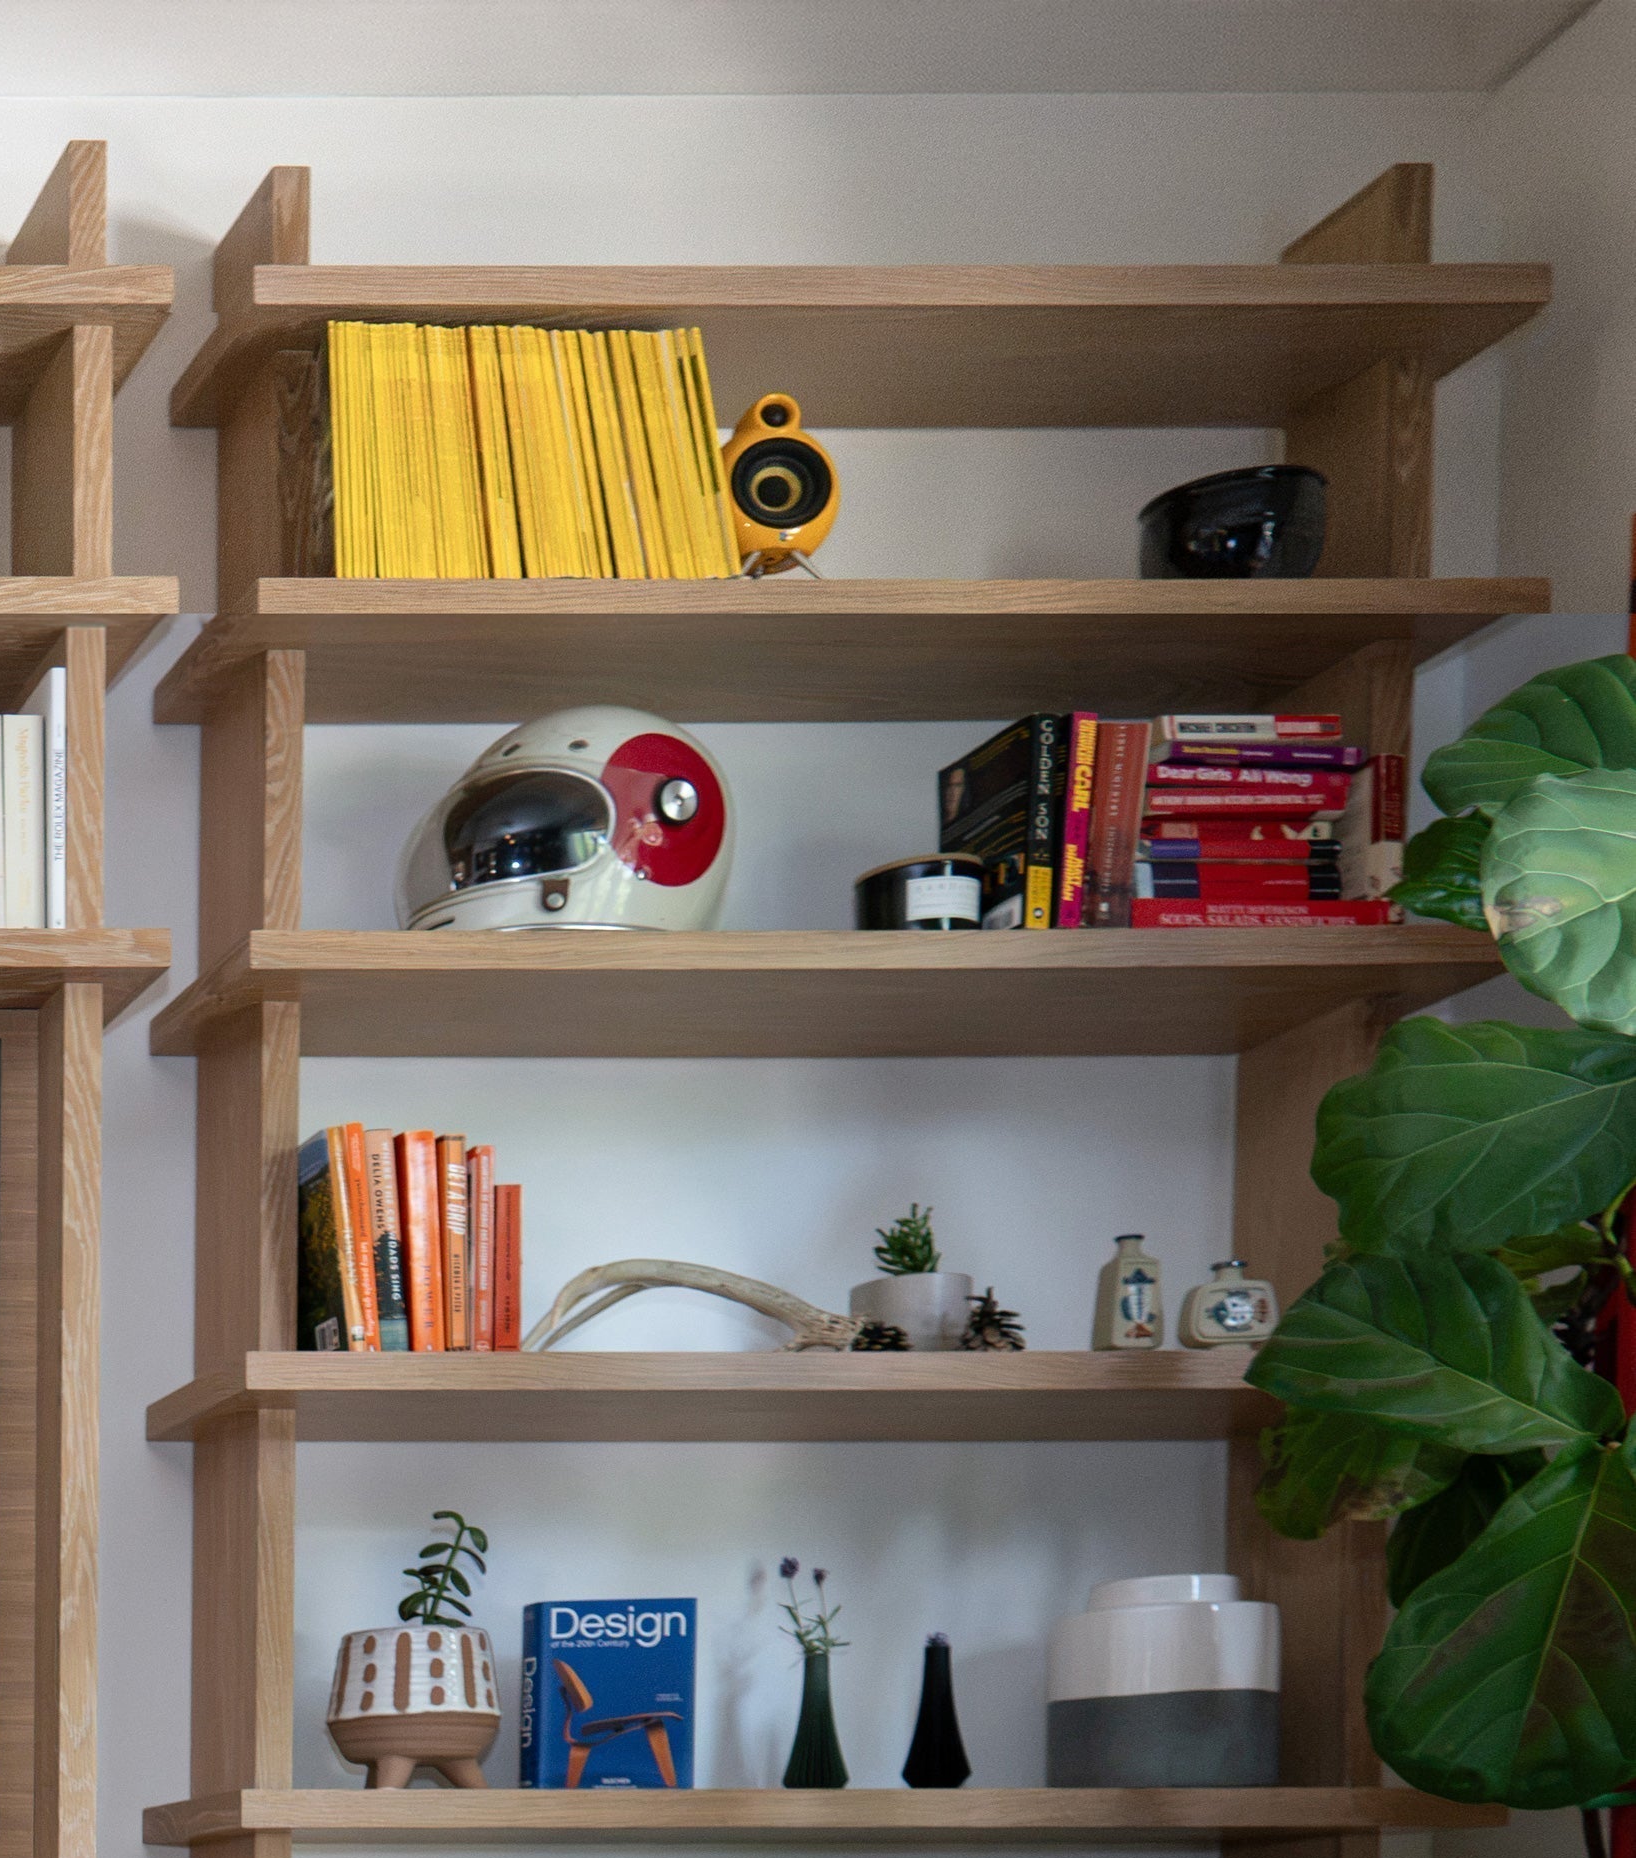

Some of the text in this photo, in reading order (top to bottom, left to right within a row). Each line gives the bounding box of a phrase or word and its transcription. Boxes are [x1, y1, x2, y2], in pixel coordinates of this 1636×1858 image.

[54, 752, 64, 861] THE ROLEX MAGAZINE
[1035, 720, 1054, 839] GOLDEN SON
[1072, 765, 1090, 812] CARL
[372, 1154, 384, 1229] DELIA OWENS
[447, 1163, 466, 1235] GET A GRIP
[550, 1606, 687, 1647] Design
